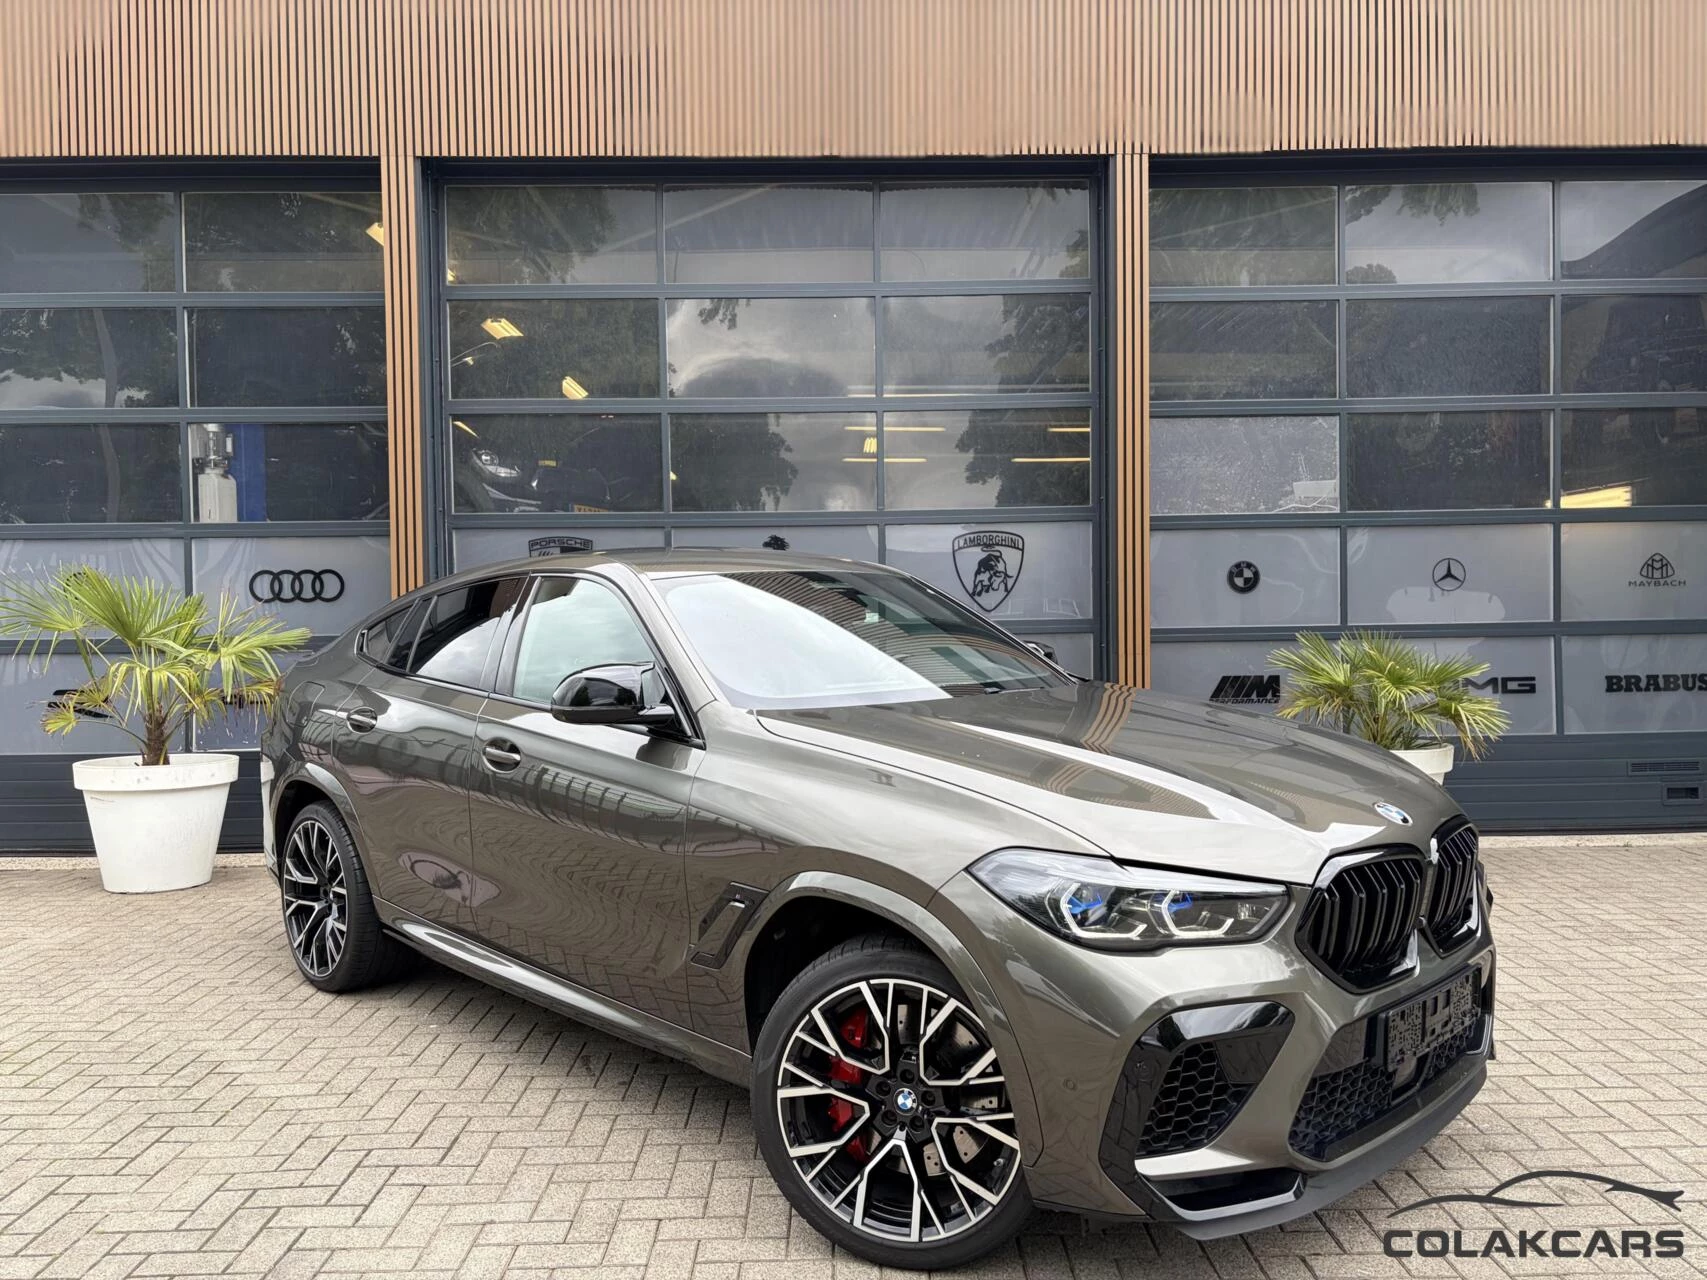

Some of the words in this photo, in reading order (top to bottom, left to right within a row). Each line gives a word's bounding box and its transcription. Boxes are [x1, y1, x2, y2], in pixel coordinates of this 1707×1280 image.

[530, 538, 591, 548] PORSCHE
[957, 534, 1020, 549] LAMBORGHINI
[1628, 579, 1686, 587] MAYBACH
[1452, 676, 1537, 694] MG
[1605, 673, 1707, 693] BRABUS
